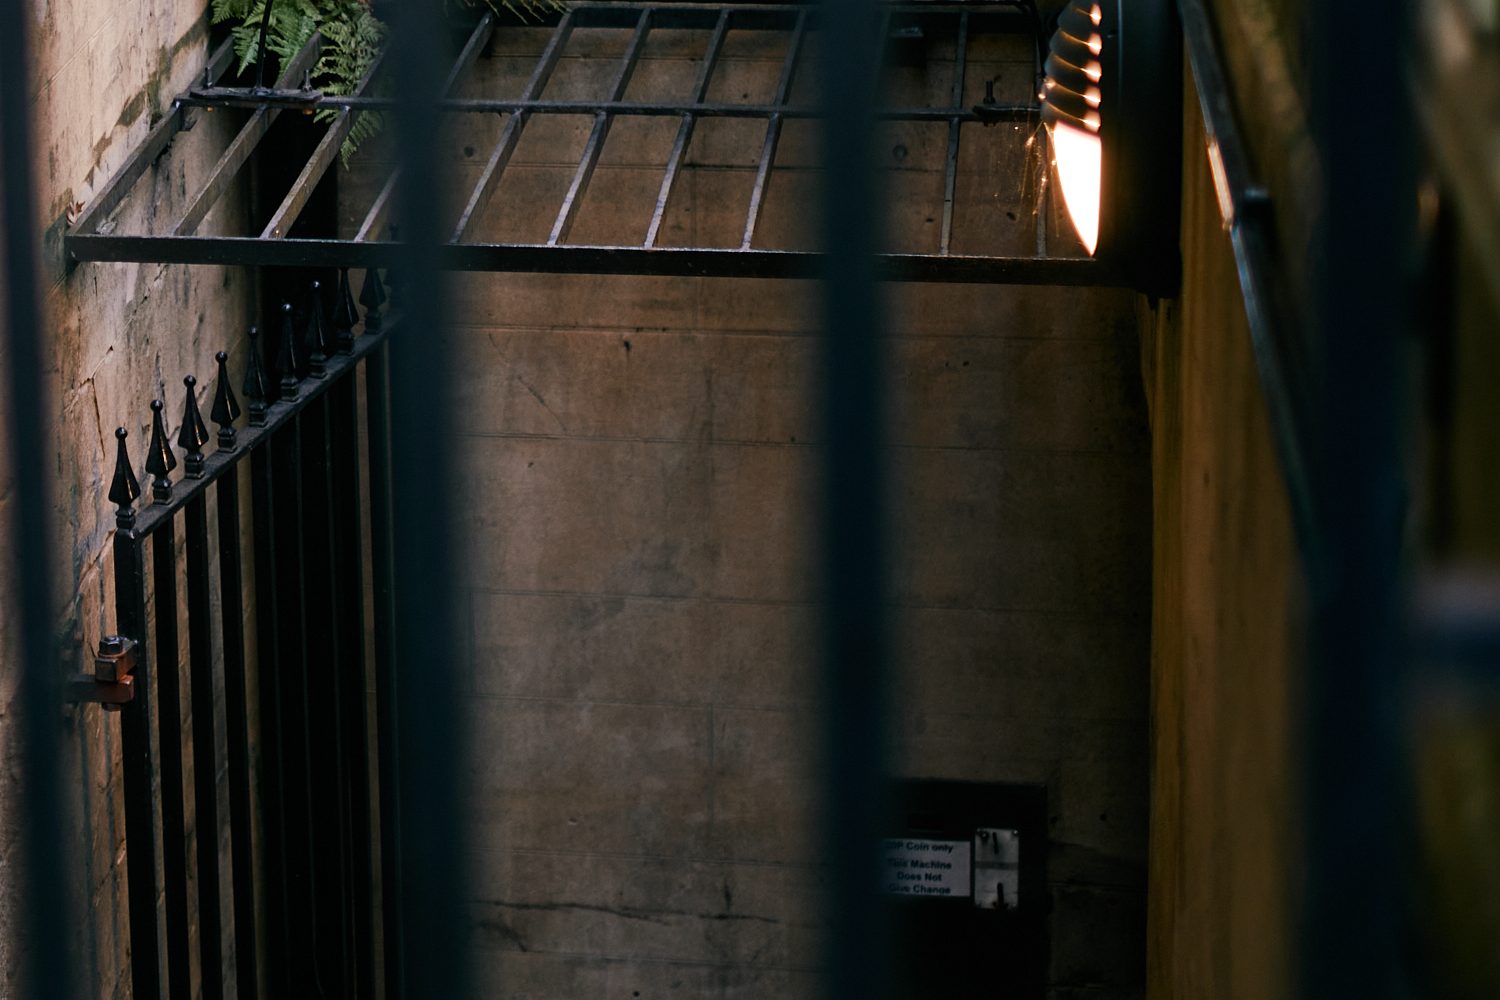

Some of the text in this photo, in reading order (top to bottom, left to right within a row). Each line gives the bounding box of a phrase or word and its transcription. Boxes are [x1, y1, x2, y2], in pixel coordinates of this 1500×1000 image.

[906, 841, 930, 850] Coin
[932, 843, 954, 854] only
[910, 860, 952, 869] Machine
[897, 871, 942, 882] Does Not
[888, 883, 951, 894] Give Change
